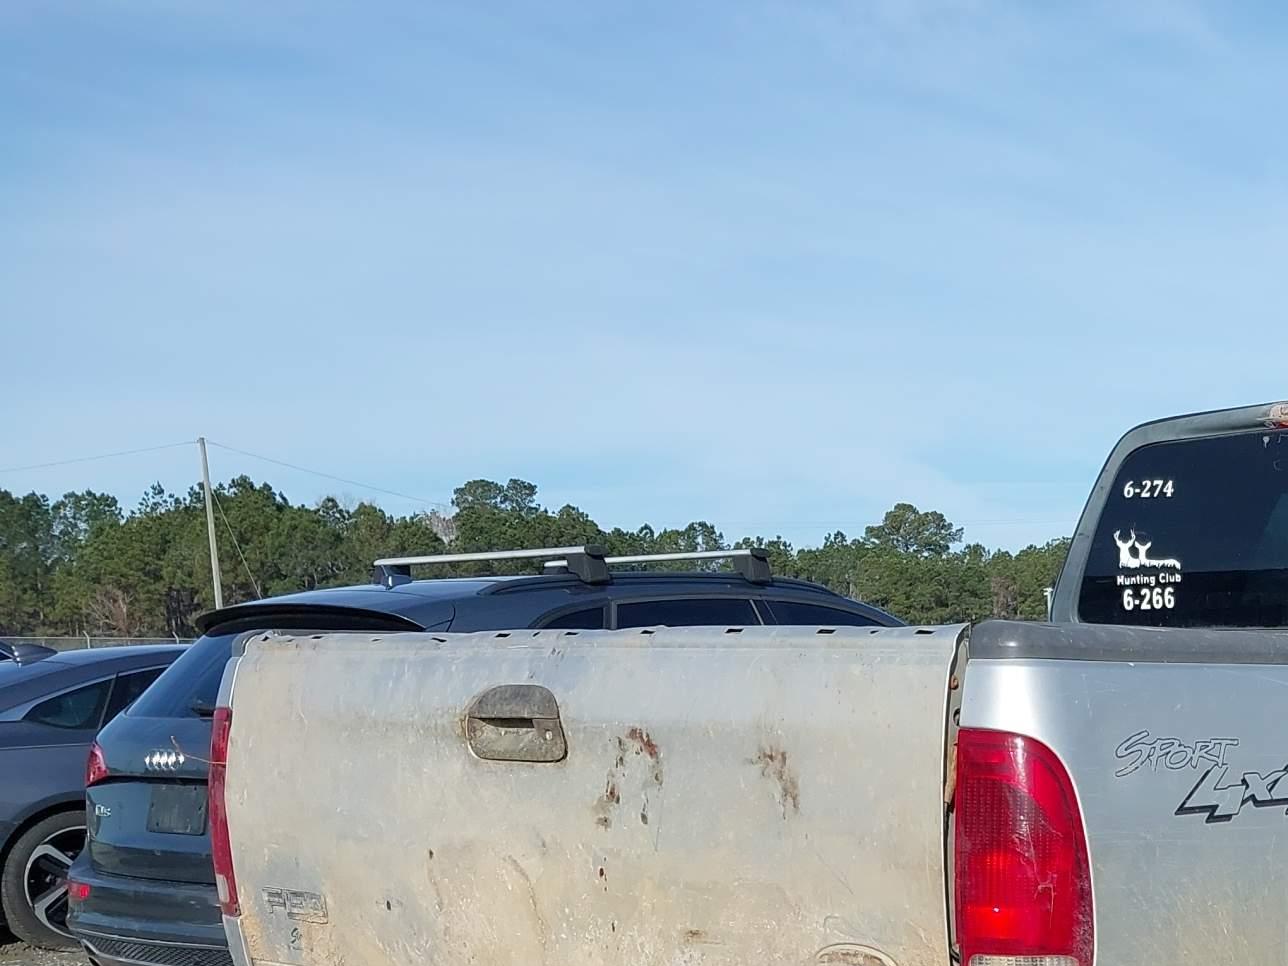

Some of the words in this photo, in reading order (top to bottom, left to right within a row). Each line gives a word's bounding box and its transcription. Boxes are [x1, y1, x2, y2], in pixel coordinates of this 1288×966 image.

[1123, 479, 1174, 498] 6-274
[1116, 574, 1156, 587] Hunting
[1159, 572, 1182, 584] Club
[1123, 587, 1175, 611] 6-266
